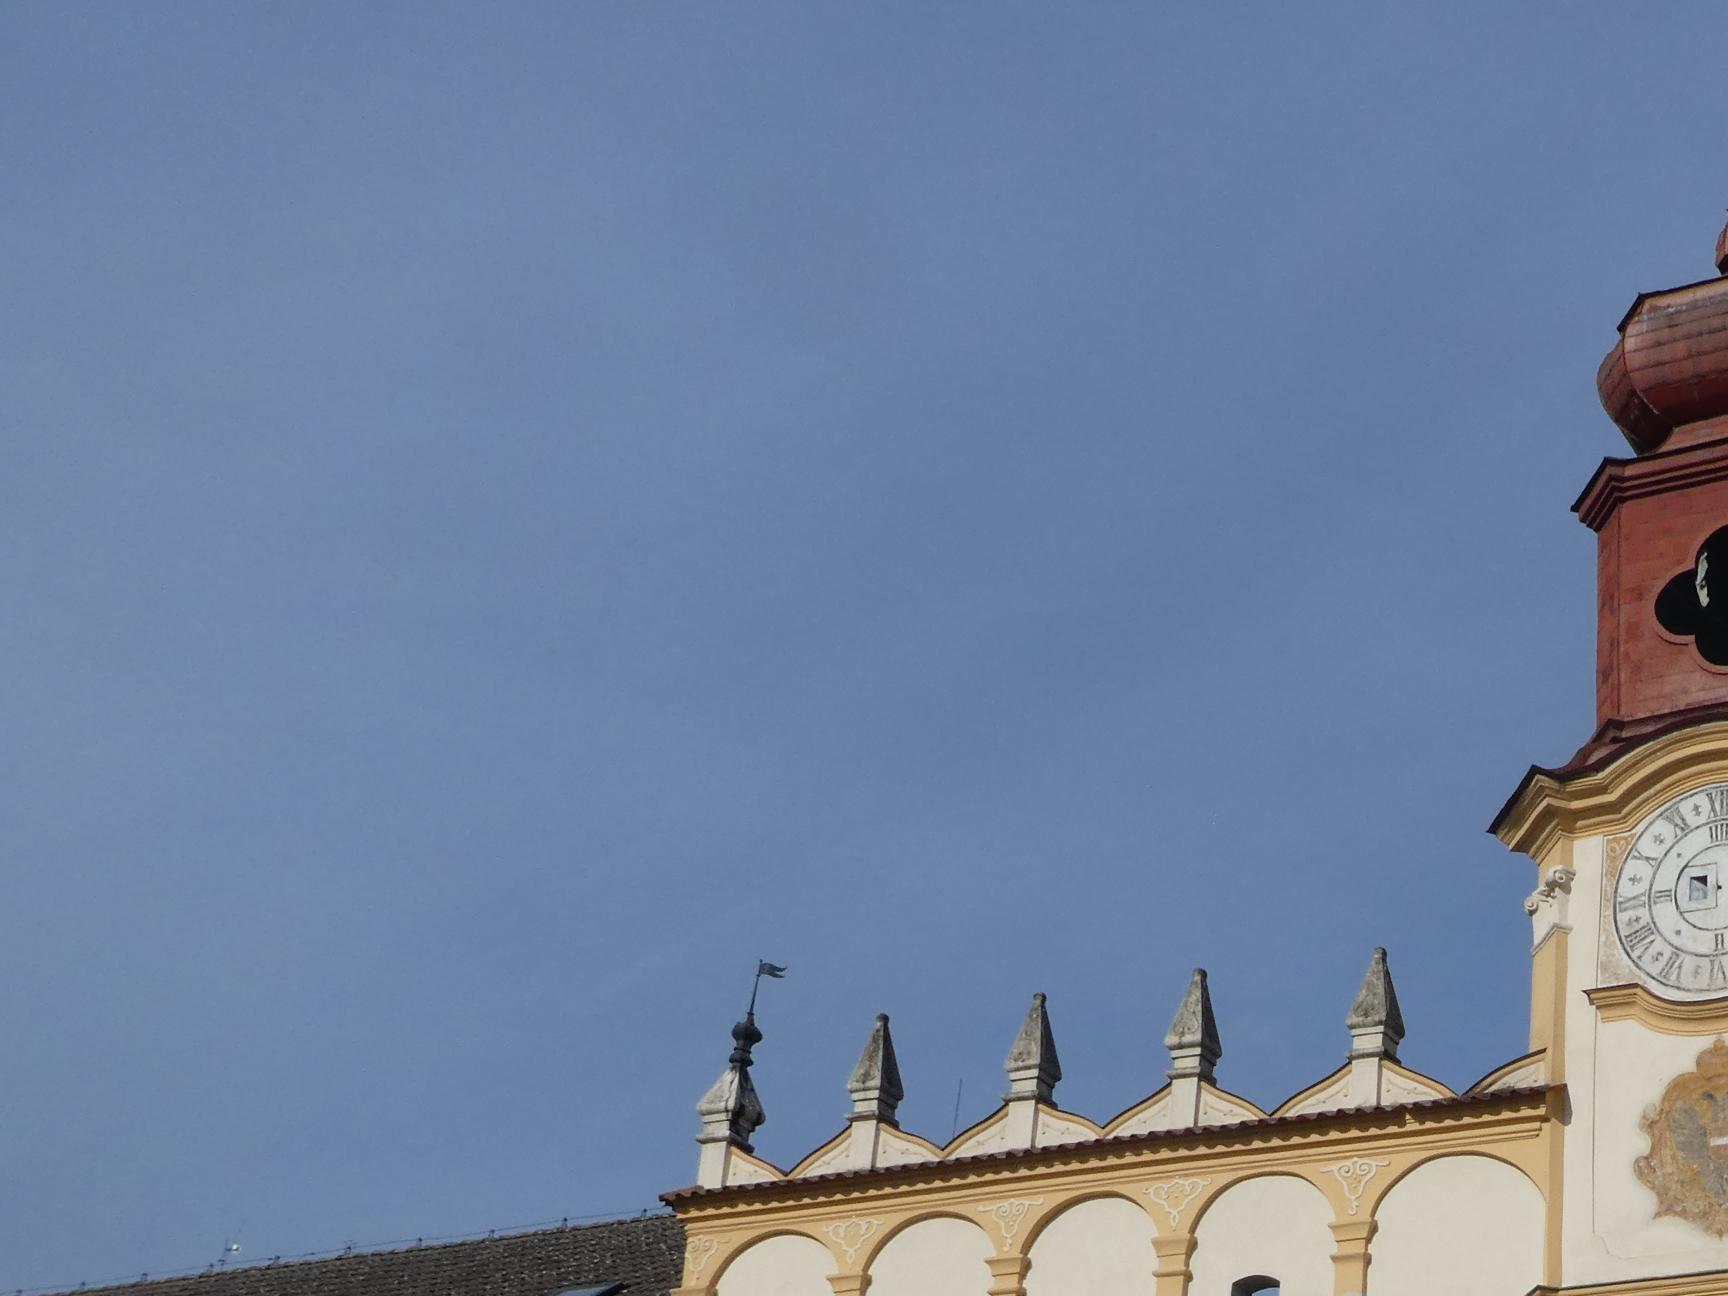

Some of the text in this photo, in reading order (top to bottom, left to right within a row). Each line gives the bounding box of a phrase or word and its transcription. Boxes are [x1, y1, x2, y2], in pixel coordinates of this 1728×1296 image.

[1662, 806, 1691, 838] XI
[1709, 823, 1728, 842] IIII
[1631, 849, 1658, 867] X
[1617, 889, 1647, 912] IX
[1654, 889, 1673, 904] III
[1624, 925, 1655, 961] VIII
[1714, 933, 1725, 951] II
[1659, 951, 1683, 983] VII
[1709, 959, 1727, 986] VI
